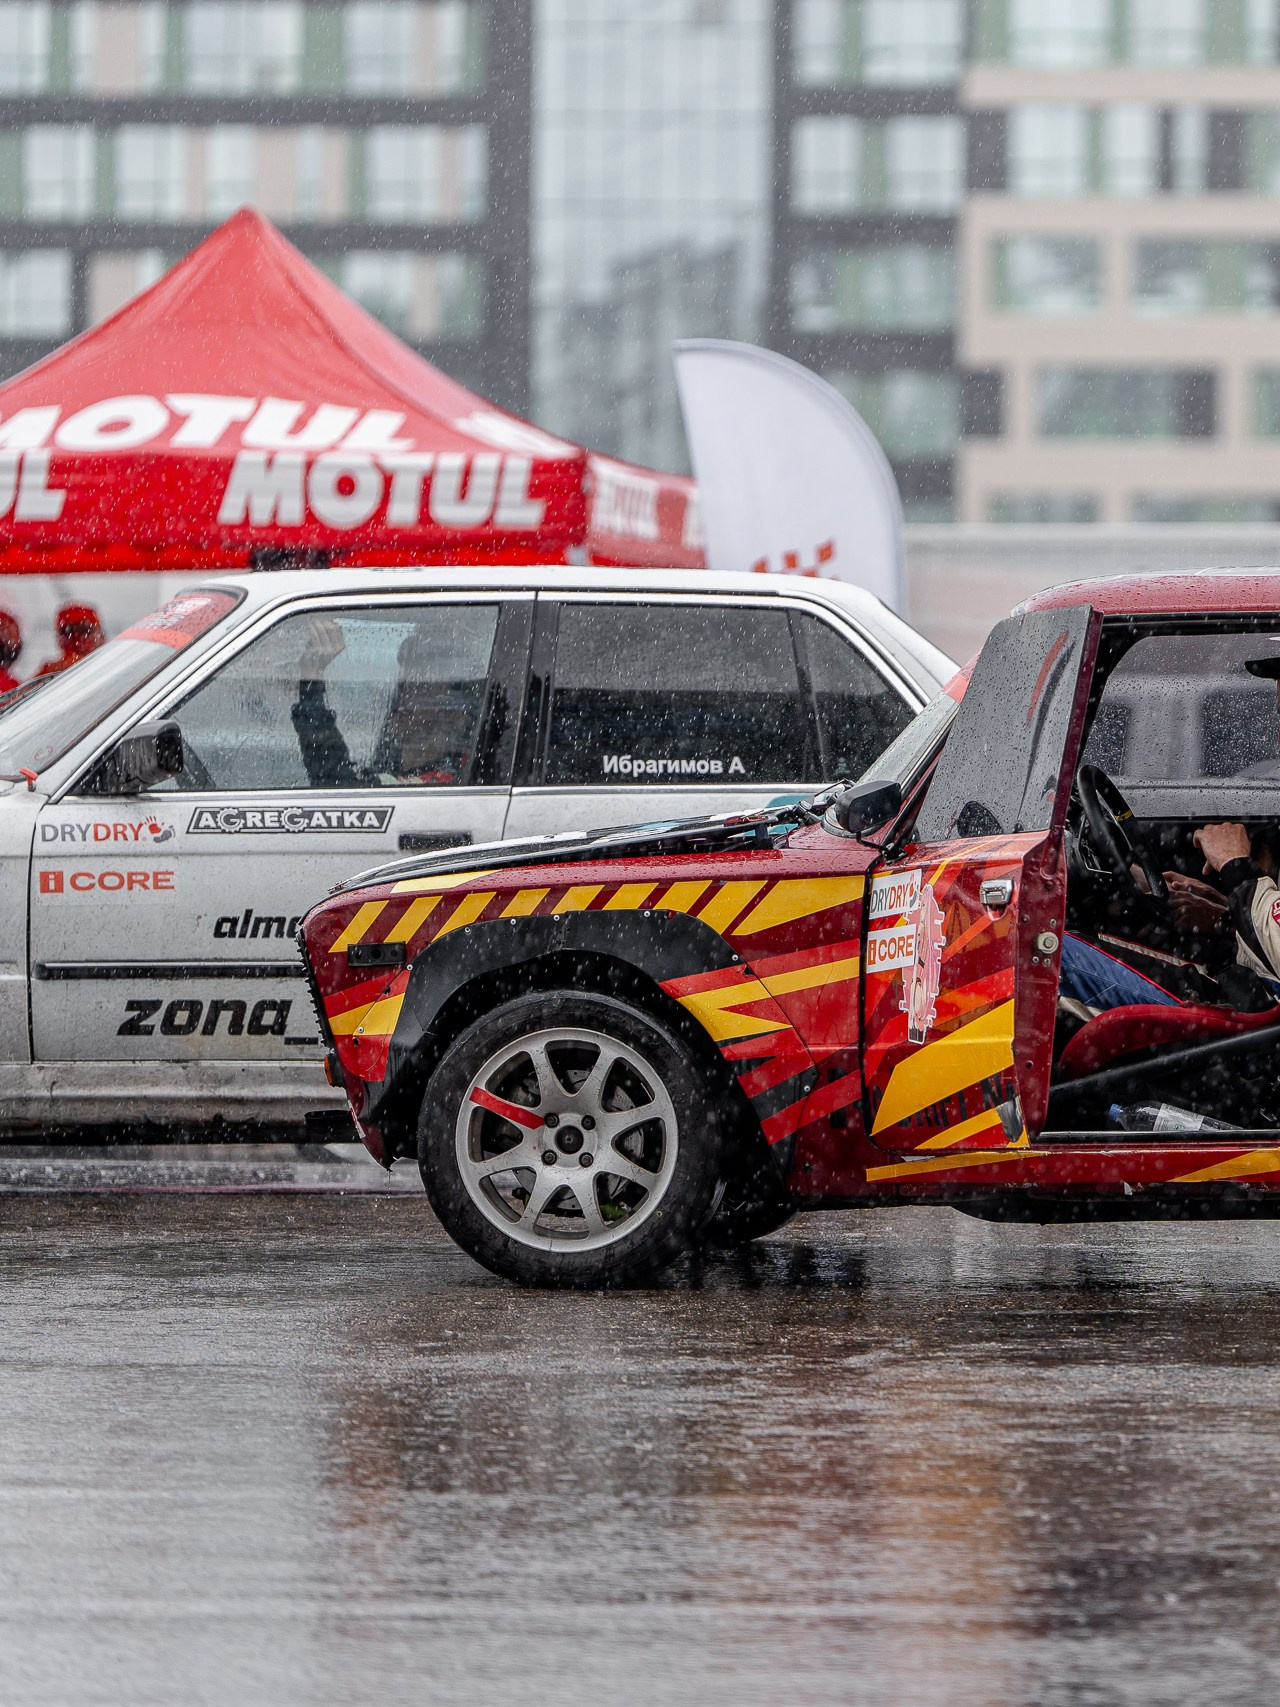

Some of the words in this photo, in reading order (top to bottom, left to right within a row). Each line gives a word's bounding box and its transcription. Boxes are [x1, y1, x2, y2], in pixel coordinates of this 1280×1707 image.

[216, 449, 546, 530] MOTUL
[602, 755, 723, 777] Ибрагимов
[728, 756, 746, 774] А
[199, 808, 383, 832] AGREGATKA
